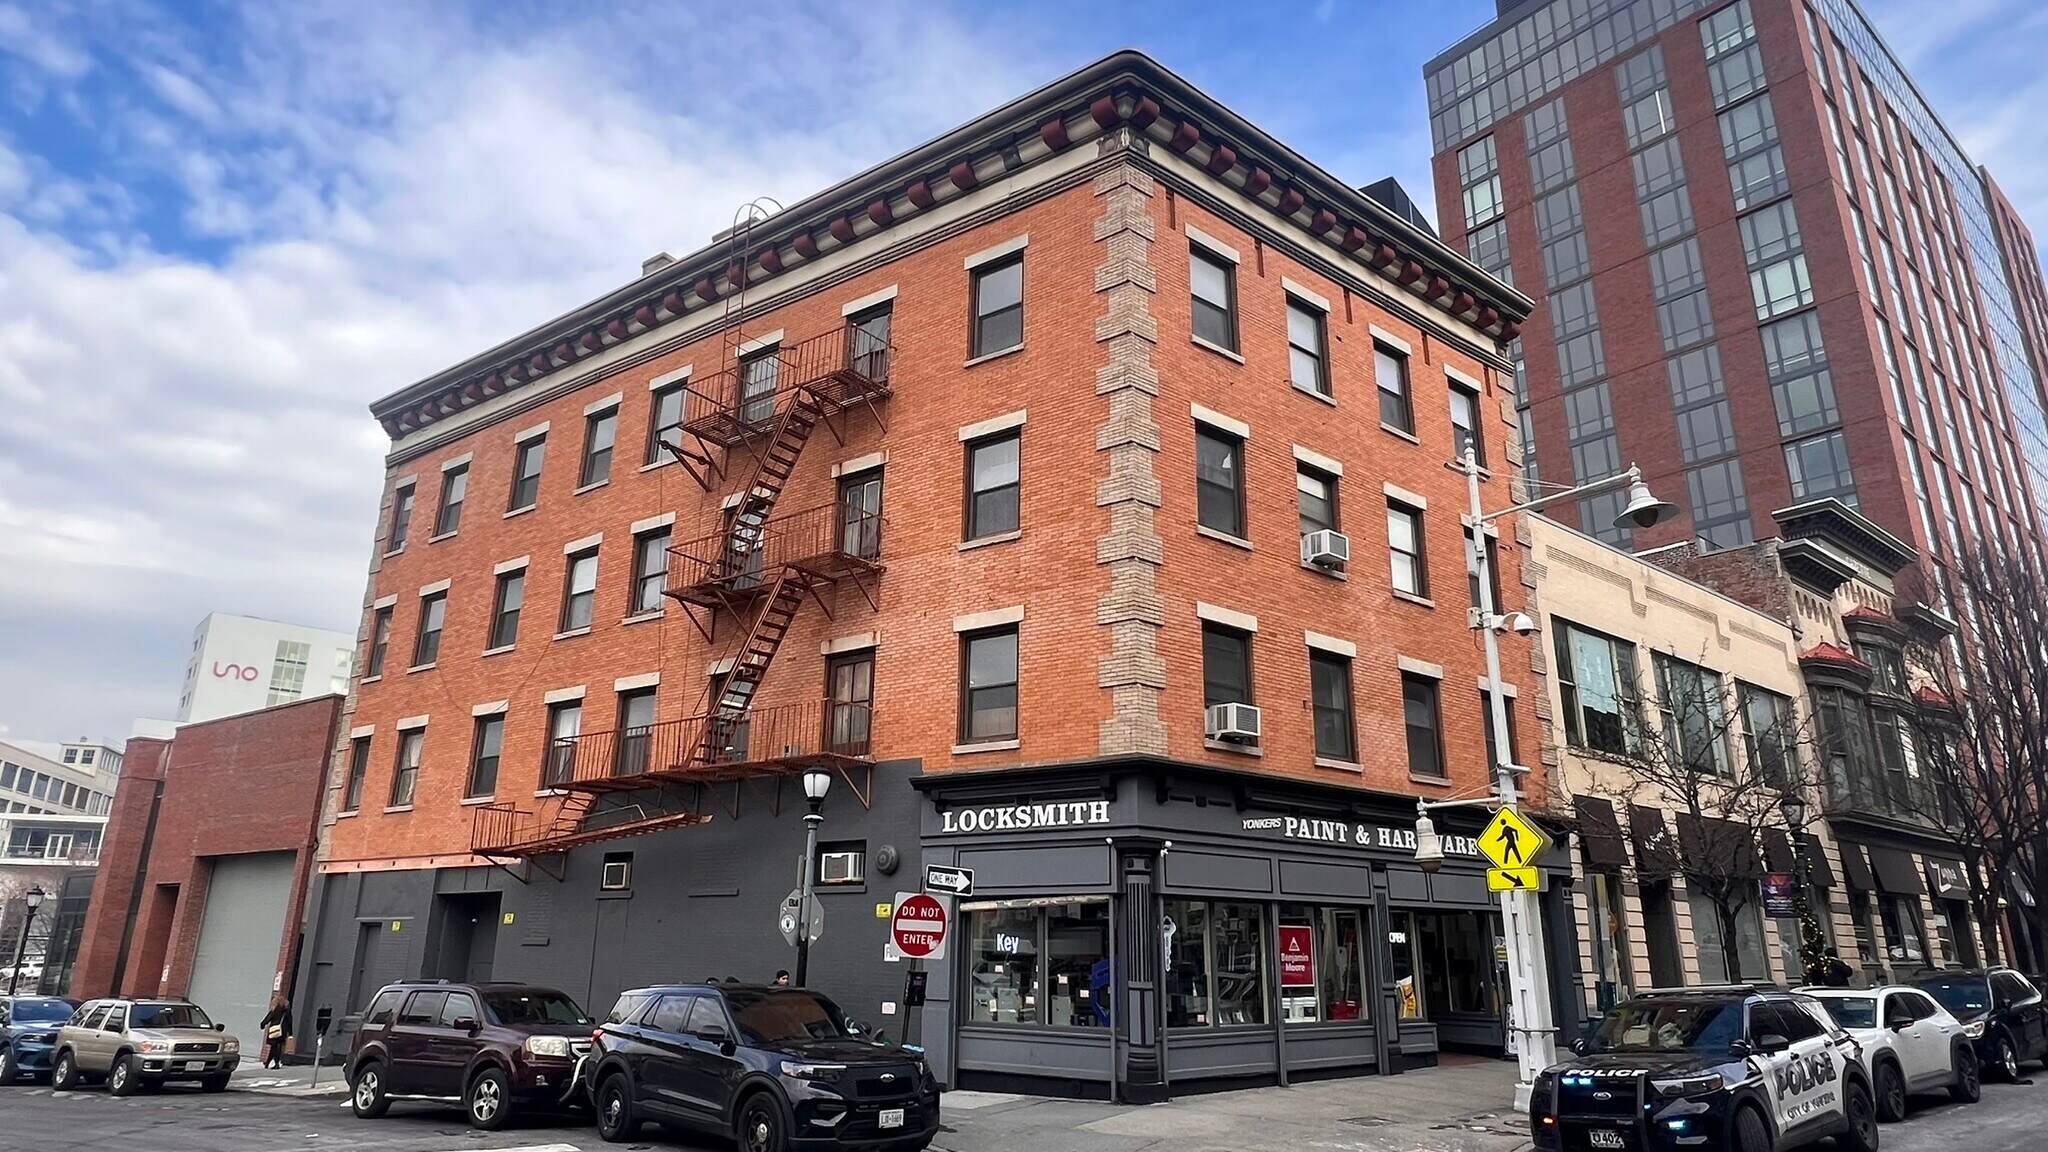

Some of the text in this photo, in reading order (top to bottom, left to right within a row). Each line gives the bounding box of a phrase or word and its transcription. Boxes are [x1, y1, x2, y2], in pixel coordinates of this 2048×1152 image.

[942, 801, 1110, 833] LOCKSMITH
[1242, 816, 1478, 856] YONKERS PAINT & HARARE
[931, 872, 958, 886] ONE WAY
[902, 905, 940, 918] DO NOT
[903, 933, 934, 946] ENTER
[996, 933, 1020, 954] Key
[1389, 932, 1406, 944] OPEN
[1281, 952, 1309, 963] Benjamin
[1285, 962, 1306, 972] Moore
[1565, 1069, 1649, 1077] POLICE
[1774, 1051, 1837, 1101] POLICE
[1787, 1104, 1802, 1120] CITY
[1801, 1101, 1811, 1113] OF
